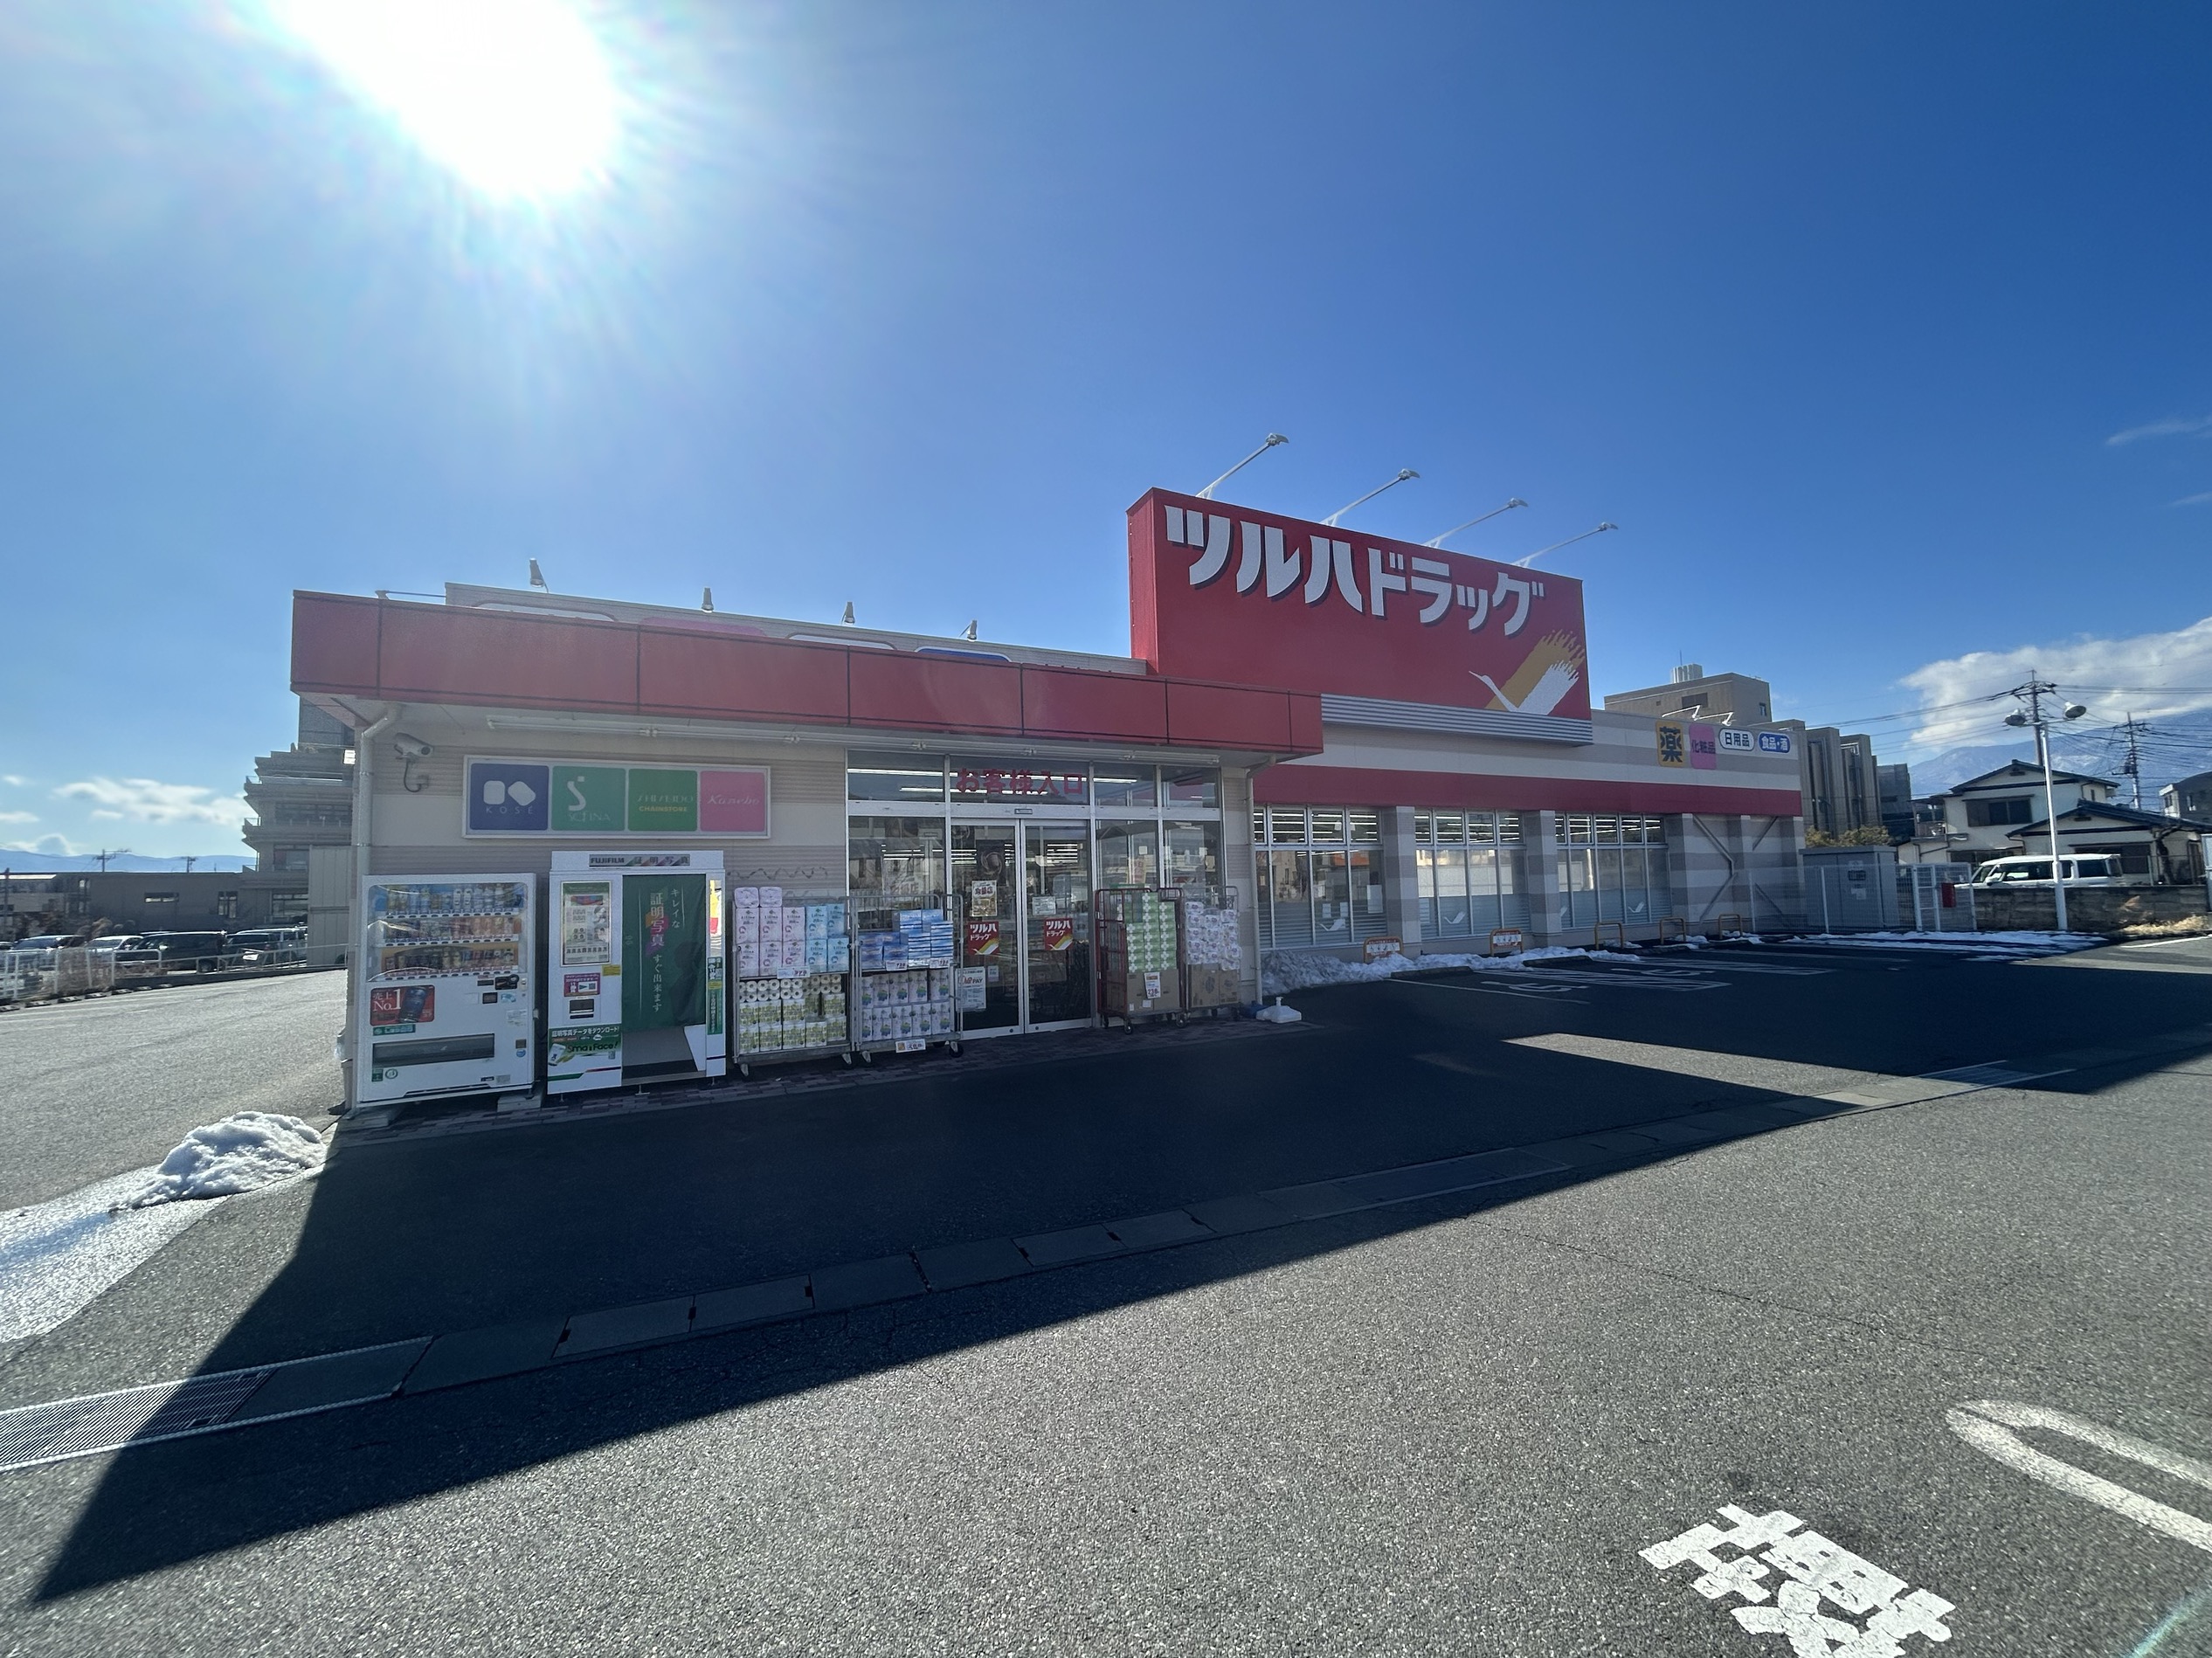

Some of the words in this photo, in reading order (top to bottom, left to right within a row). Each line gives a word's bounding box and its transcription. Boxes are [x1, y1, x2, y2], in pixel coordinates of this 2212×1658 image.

[1165, 505, 1545, 636] ツルハドラッグ
[1660, 726, 1683, 763] 薬
[1691, 739, 1716, 754] 化粧品
[1725, 732, 1750, 747] 日用品
[956, 768, 1083, 795] お客様入口
[650, 892, 664, 946] 証明写真
[670, 888, 681, 929] キレイな
[1046, 920, 1071, 929] ツルハ
[970, 923, 997, 933] ツルハ
[653, 954, 662, 1012] すぐ出来ます
